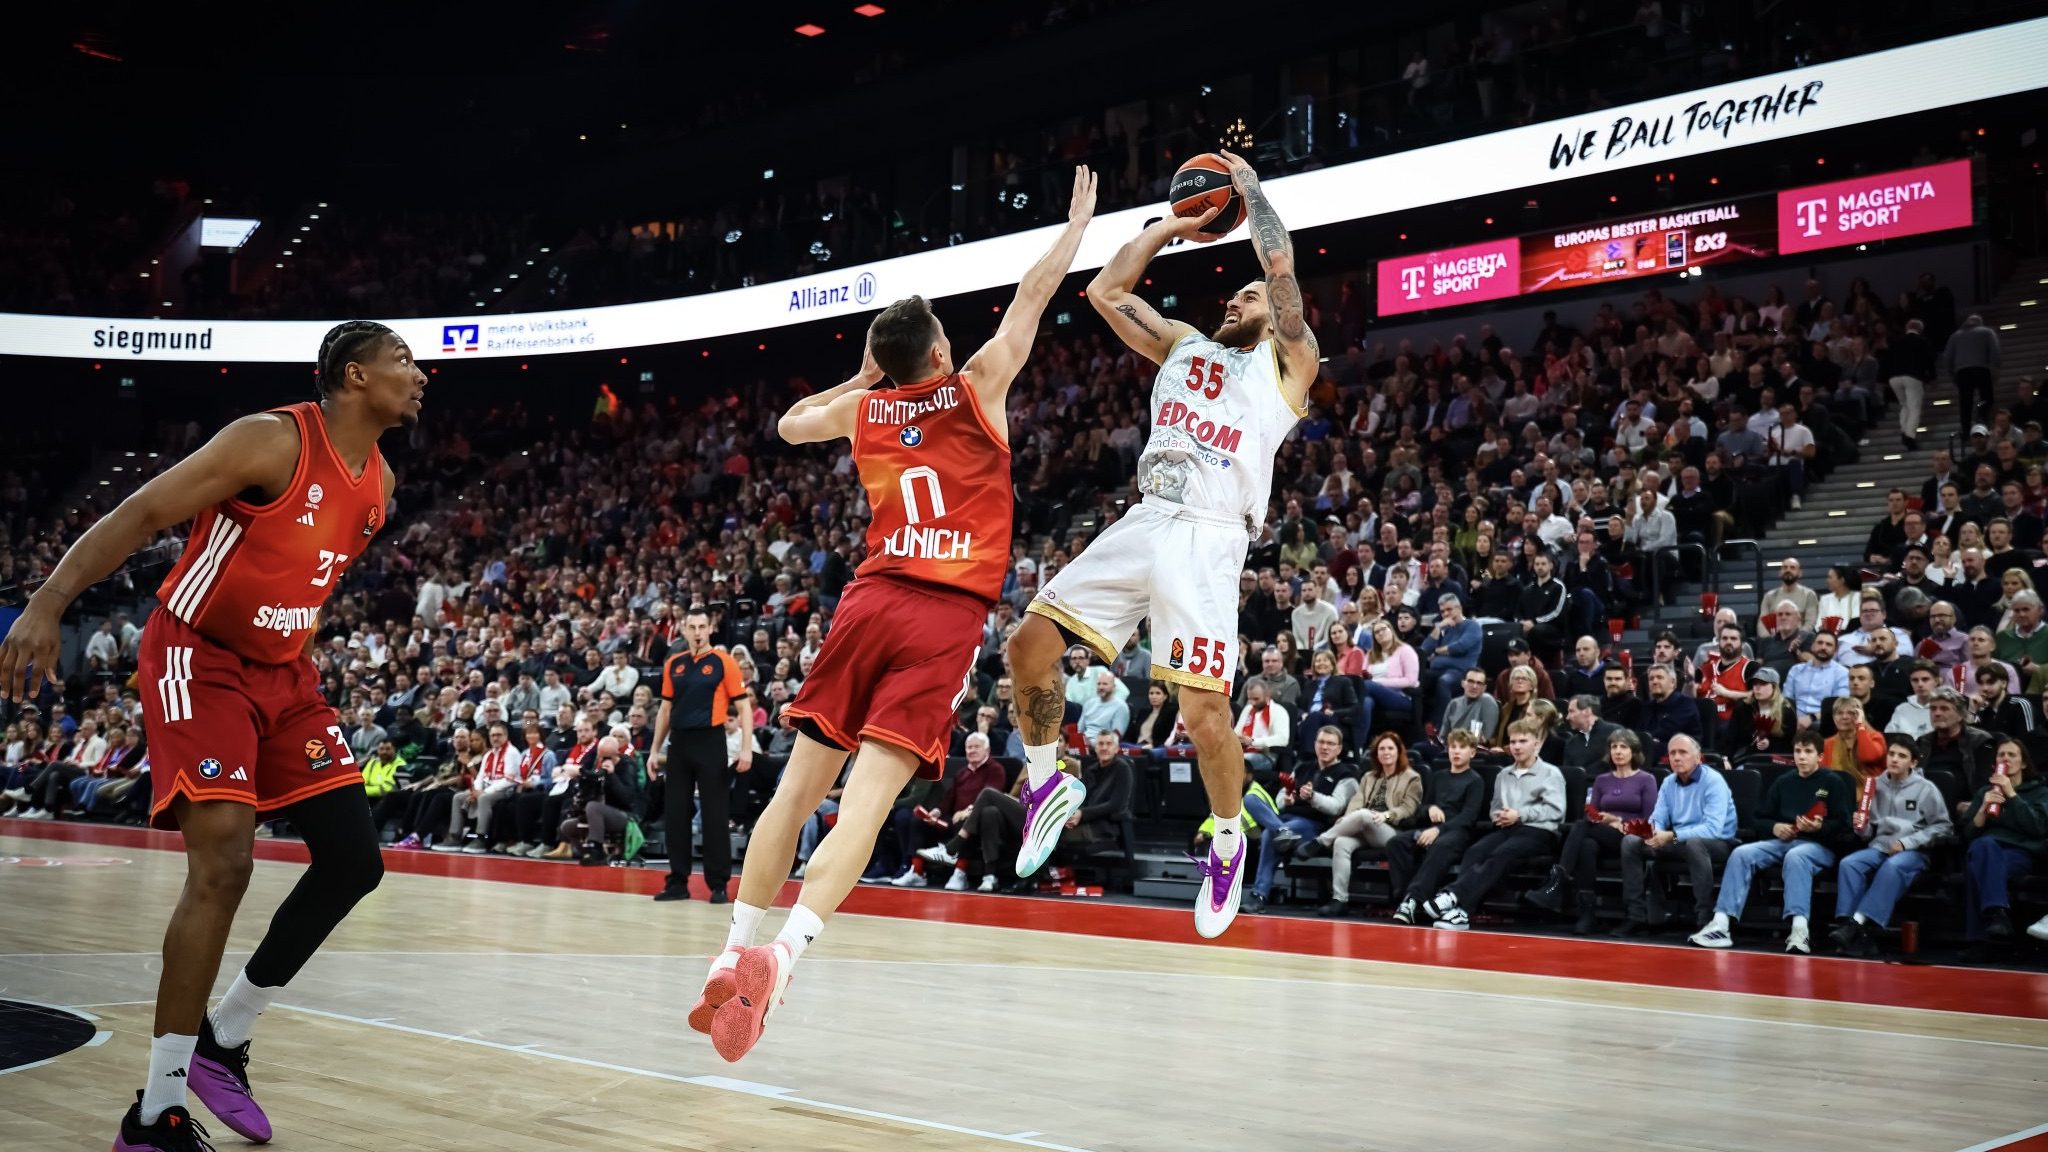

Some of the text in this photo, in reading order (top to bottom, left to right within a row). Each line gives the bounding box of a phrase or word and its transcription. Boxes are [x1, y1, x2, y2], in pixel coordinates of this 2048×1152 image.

[1549, 128, 1598, 170] WE
[1604, 115, 1676, 160] BALL
[1838, 181, 1935, 212] MAGENTA
[1554, 205, 1739, 248] EUROPAS BESTER BASKETBALL
[1838, 205, 1901, 231] SPORT
[1433, 253, 1507, 279] MAGENTA
[1433, 273, 1480, 296] SPORT
[788, 286, 849, 312] Allianz
[487, 317, 588, 334] meine Volksbank
[93, 325, 212, 355] siegmund
[487, 332, 595, 350] Raiffeisenbank eG
[1185, 356, 1225, 400] 55
[1188, 636, 1226, 679] 55
